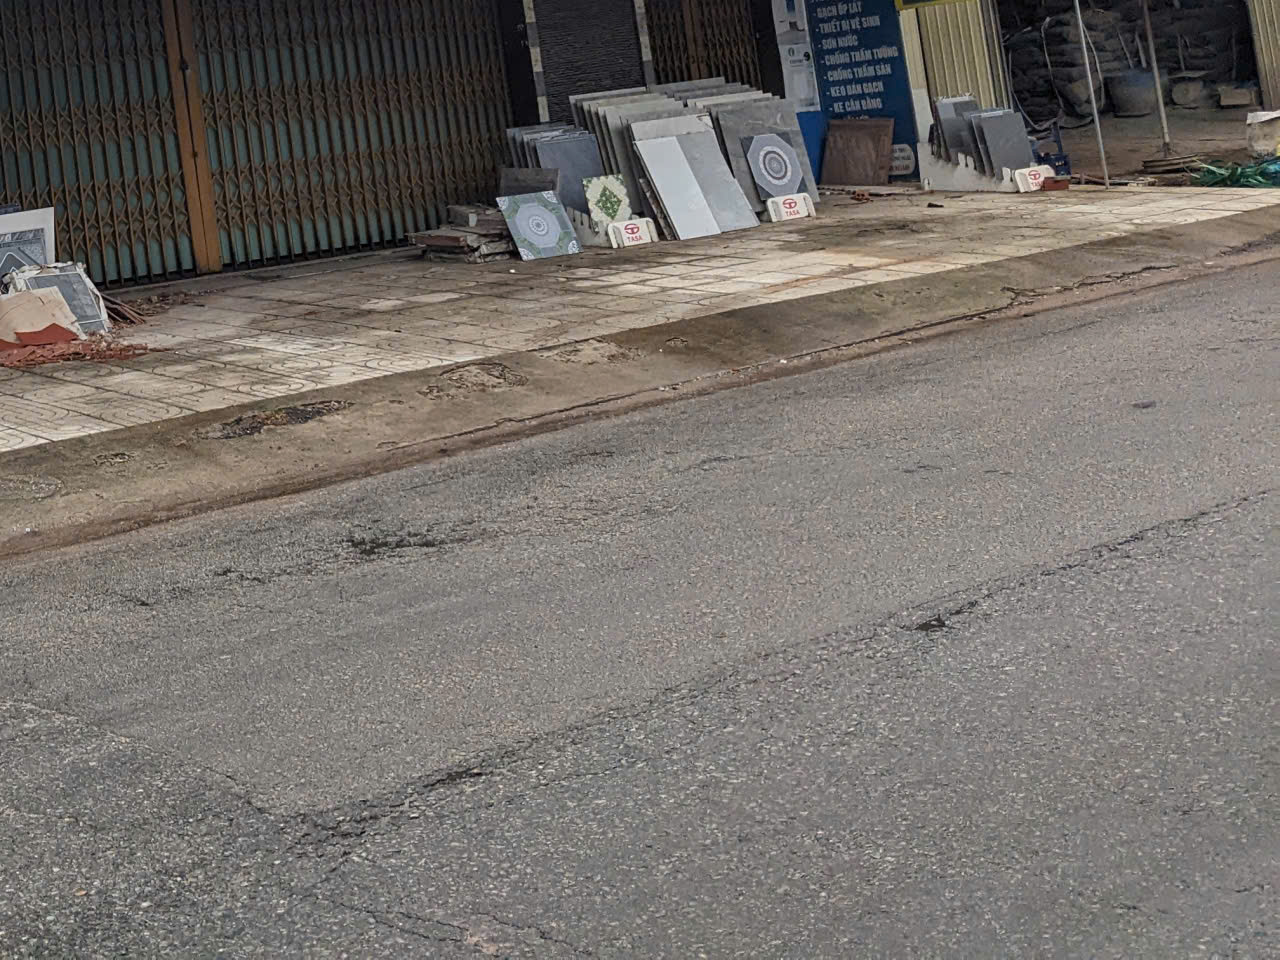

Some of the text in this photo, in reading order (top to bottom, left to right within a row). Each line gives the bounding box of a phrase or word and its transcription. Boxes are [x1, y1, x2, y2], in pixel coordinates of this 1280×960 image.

[830, 86, 846, 97] KEO
[784, 208, 801, 218] TASA
[626, 235, 643, 244] TASA
